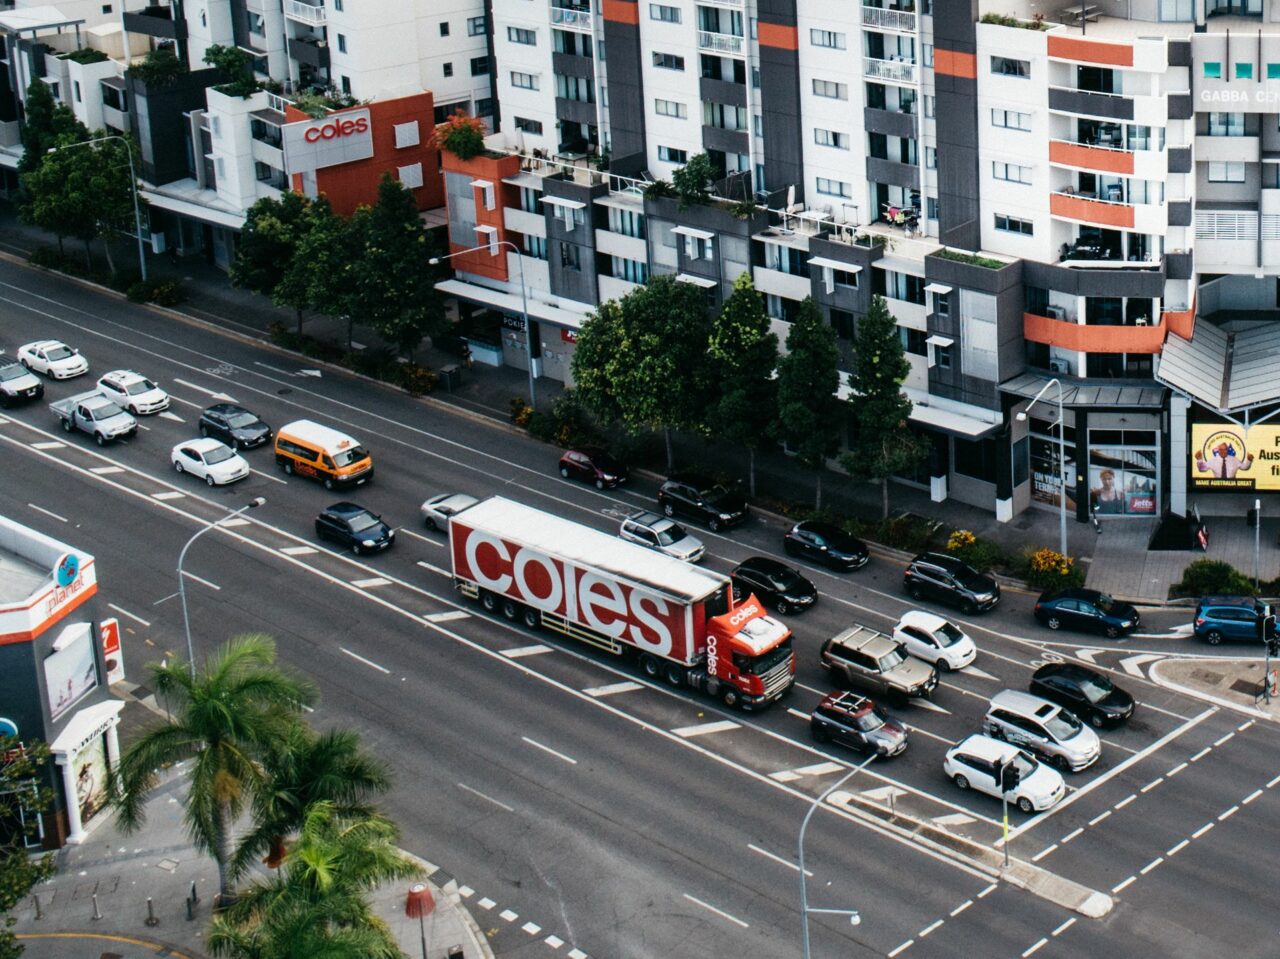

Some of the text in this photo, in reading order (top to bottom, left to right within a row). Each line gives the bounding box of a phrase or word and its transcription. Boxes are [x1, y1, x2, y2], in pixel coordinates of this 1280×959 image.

[1200, 89, 1249, 102] GABBA
[304, 117, 368, 143] coles
[46, 573, 84, 616] planet
[465, 528, 672, 657] coles
[730, 602, 759, 626] coles
[706, 635, 718, 676] coles
